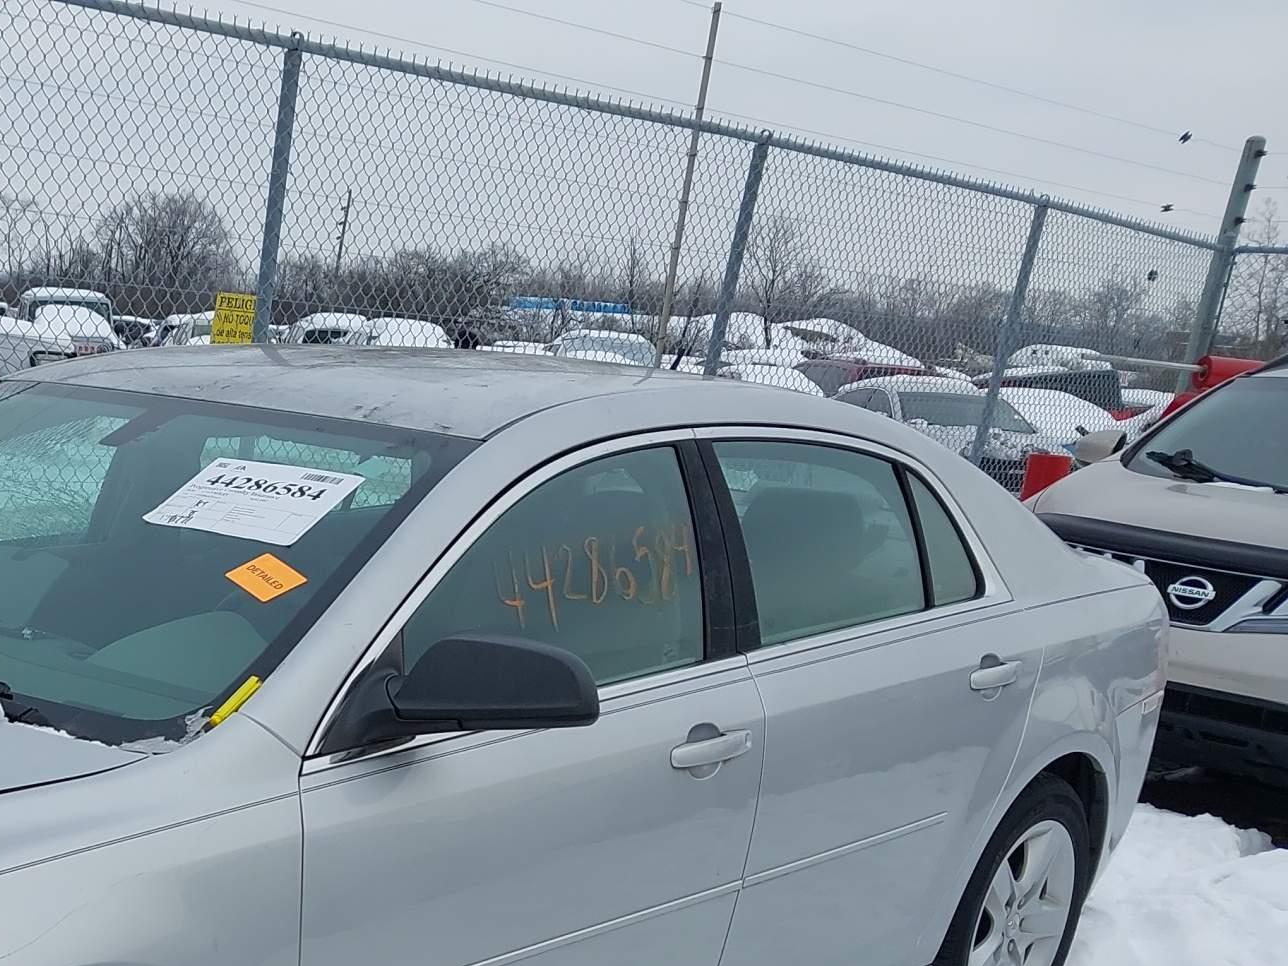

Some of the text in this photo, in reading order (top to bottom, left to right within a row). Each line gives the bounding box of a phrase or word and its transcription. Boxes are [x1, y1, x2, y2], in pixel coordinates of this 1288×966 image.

[218, 296, 256, 310] PELIG
[206, 473, 328, 501] 44286584
[246, 564, 285, 590] DETAILED
[492, 525, 693, 632] 44286584
[1171, 586, 1210, 598] NISSAN
